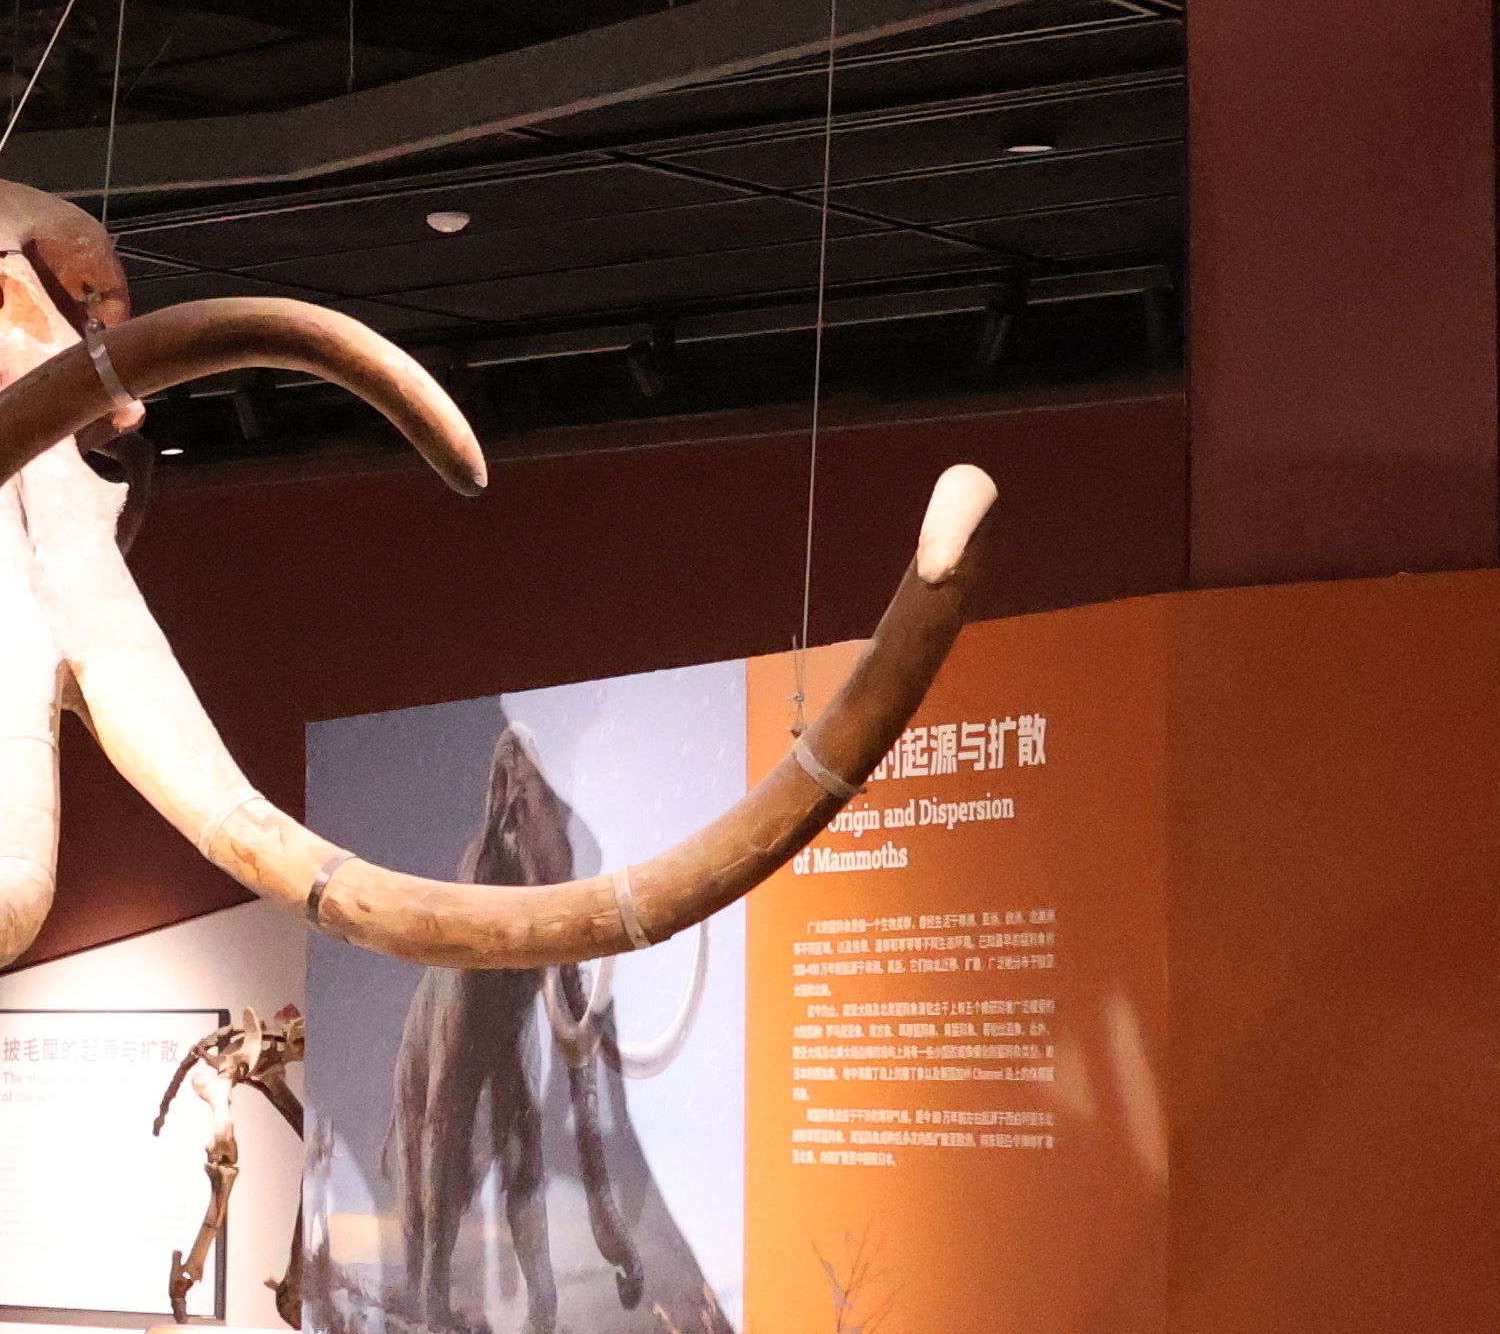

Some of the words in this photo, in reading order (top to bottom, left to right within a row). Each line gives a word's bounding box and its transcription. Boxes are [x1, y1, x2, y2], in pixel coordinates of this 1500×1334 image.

[867, 713, 1047, 783] 的起源与扩散
[884, 798, 916, 828] and
[919, 792, 1015, 830] Dispersion
[793, 846, 811, 875] of
[813, 840, 909, 874] Mammoths
[2, 1037, 180, 1063] 披毛犀的起源与扩散
[2, 1071, 24, 1084] The
[1, 1090, 13, 1103] of
[16, 1090, 33, 1103] the
